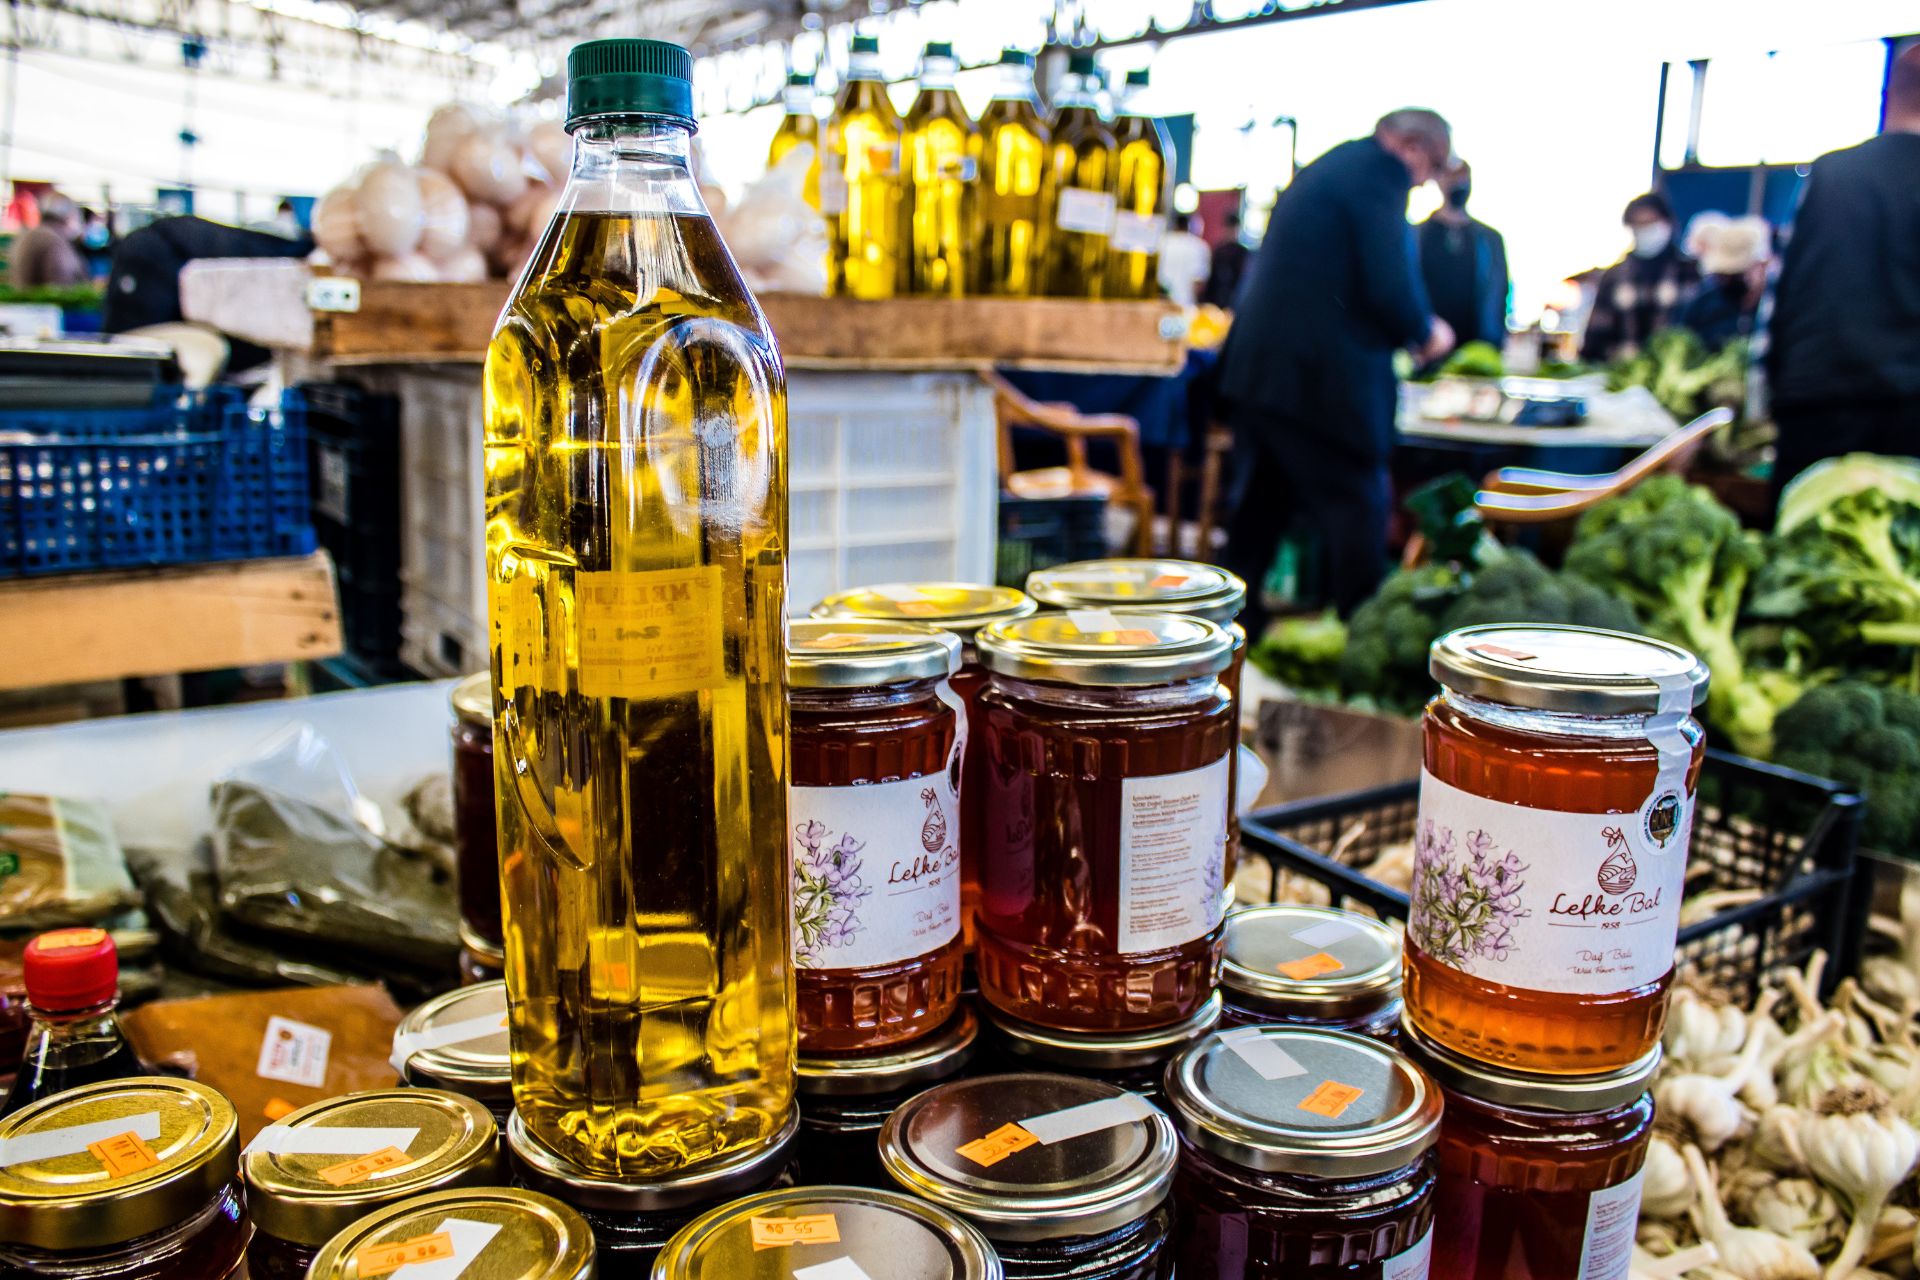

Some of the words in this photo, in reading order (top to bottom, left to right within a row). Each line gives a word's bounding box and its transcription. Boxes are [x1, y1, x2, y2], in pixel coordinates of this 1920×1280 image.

[888, 854, 941, 884] Lefke
[1549, 893, 1624, 920] Lefke
[1623, 887, 1662, 914] Bal
[1600, 921, 1620, 929] 1958
